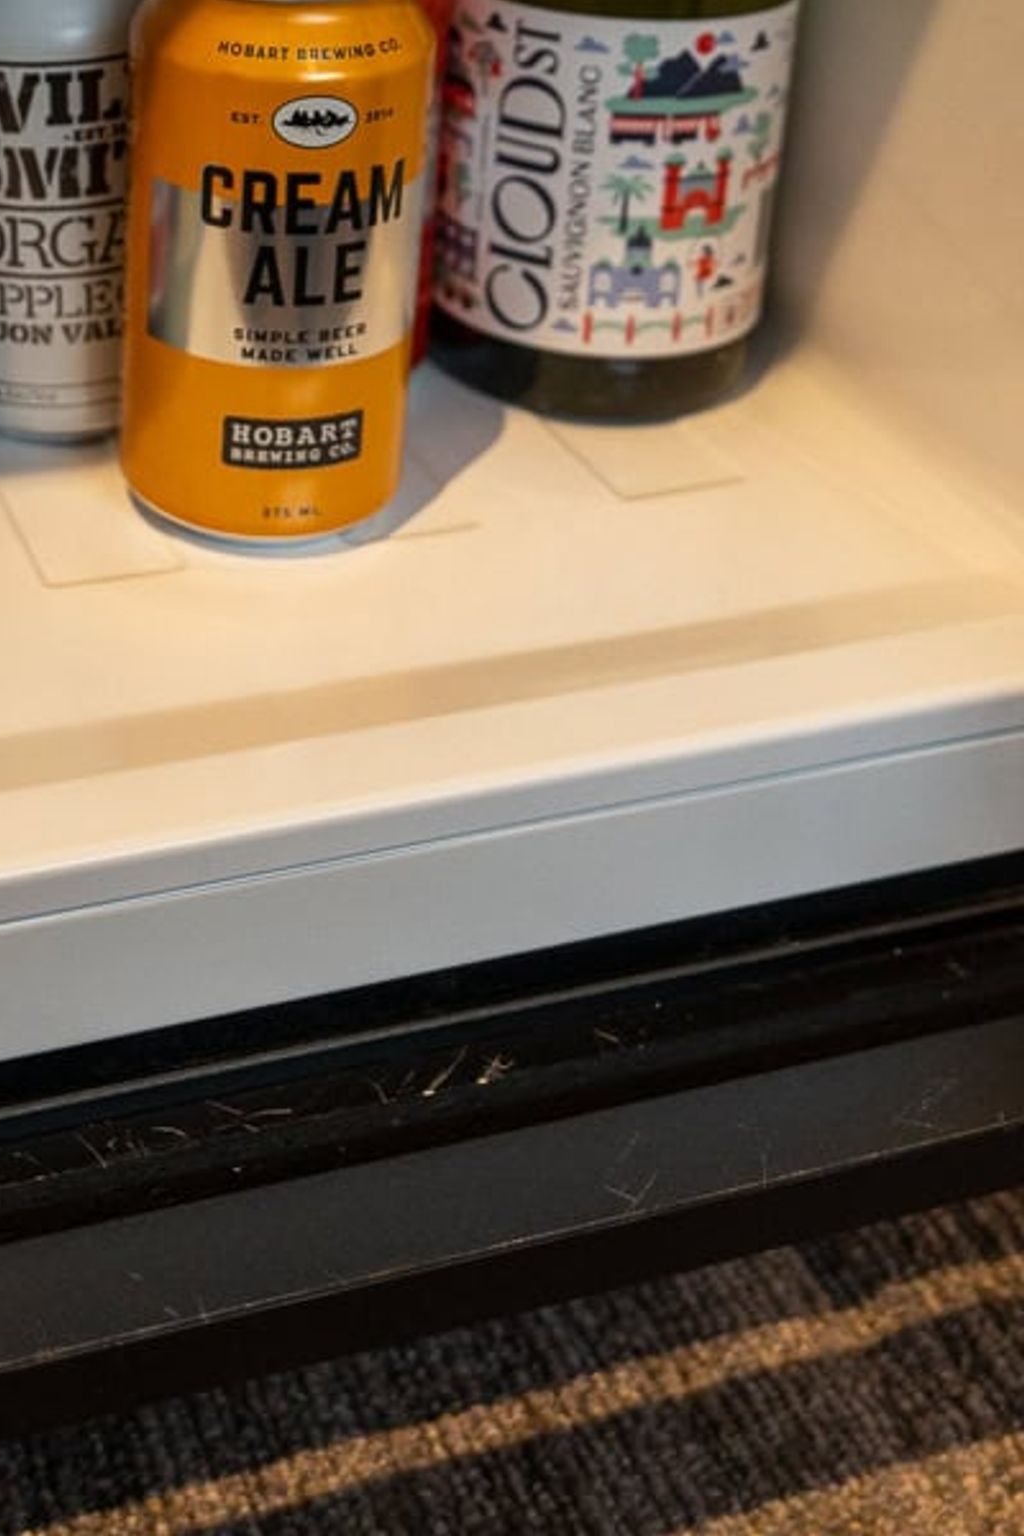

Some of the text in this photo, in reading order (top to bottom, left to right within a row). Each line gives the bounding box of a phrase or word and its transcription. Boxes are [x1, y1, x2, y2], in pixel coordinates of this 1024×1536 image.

[217, 41, 290, 62] HOBART
[297, 43, 377, 61] BREWING
[200, 159, 406, 235] CREAM
[559, 64, 603, 311] SAUVIGNON BLANC
[242, 240, 367, 308] ALE
[233, 322, 368, 346] SIMPLE BEER
[240, 343, 358, 363] MADE WELL
[231, 417, 358, 447] HOBART
[229, 446, 321, 463] BREWING
